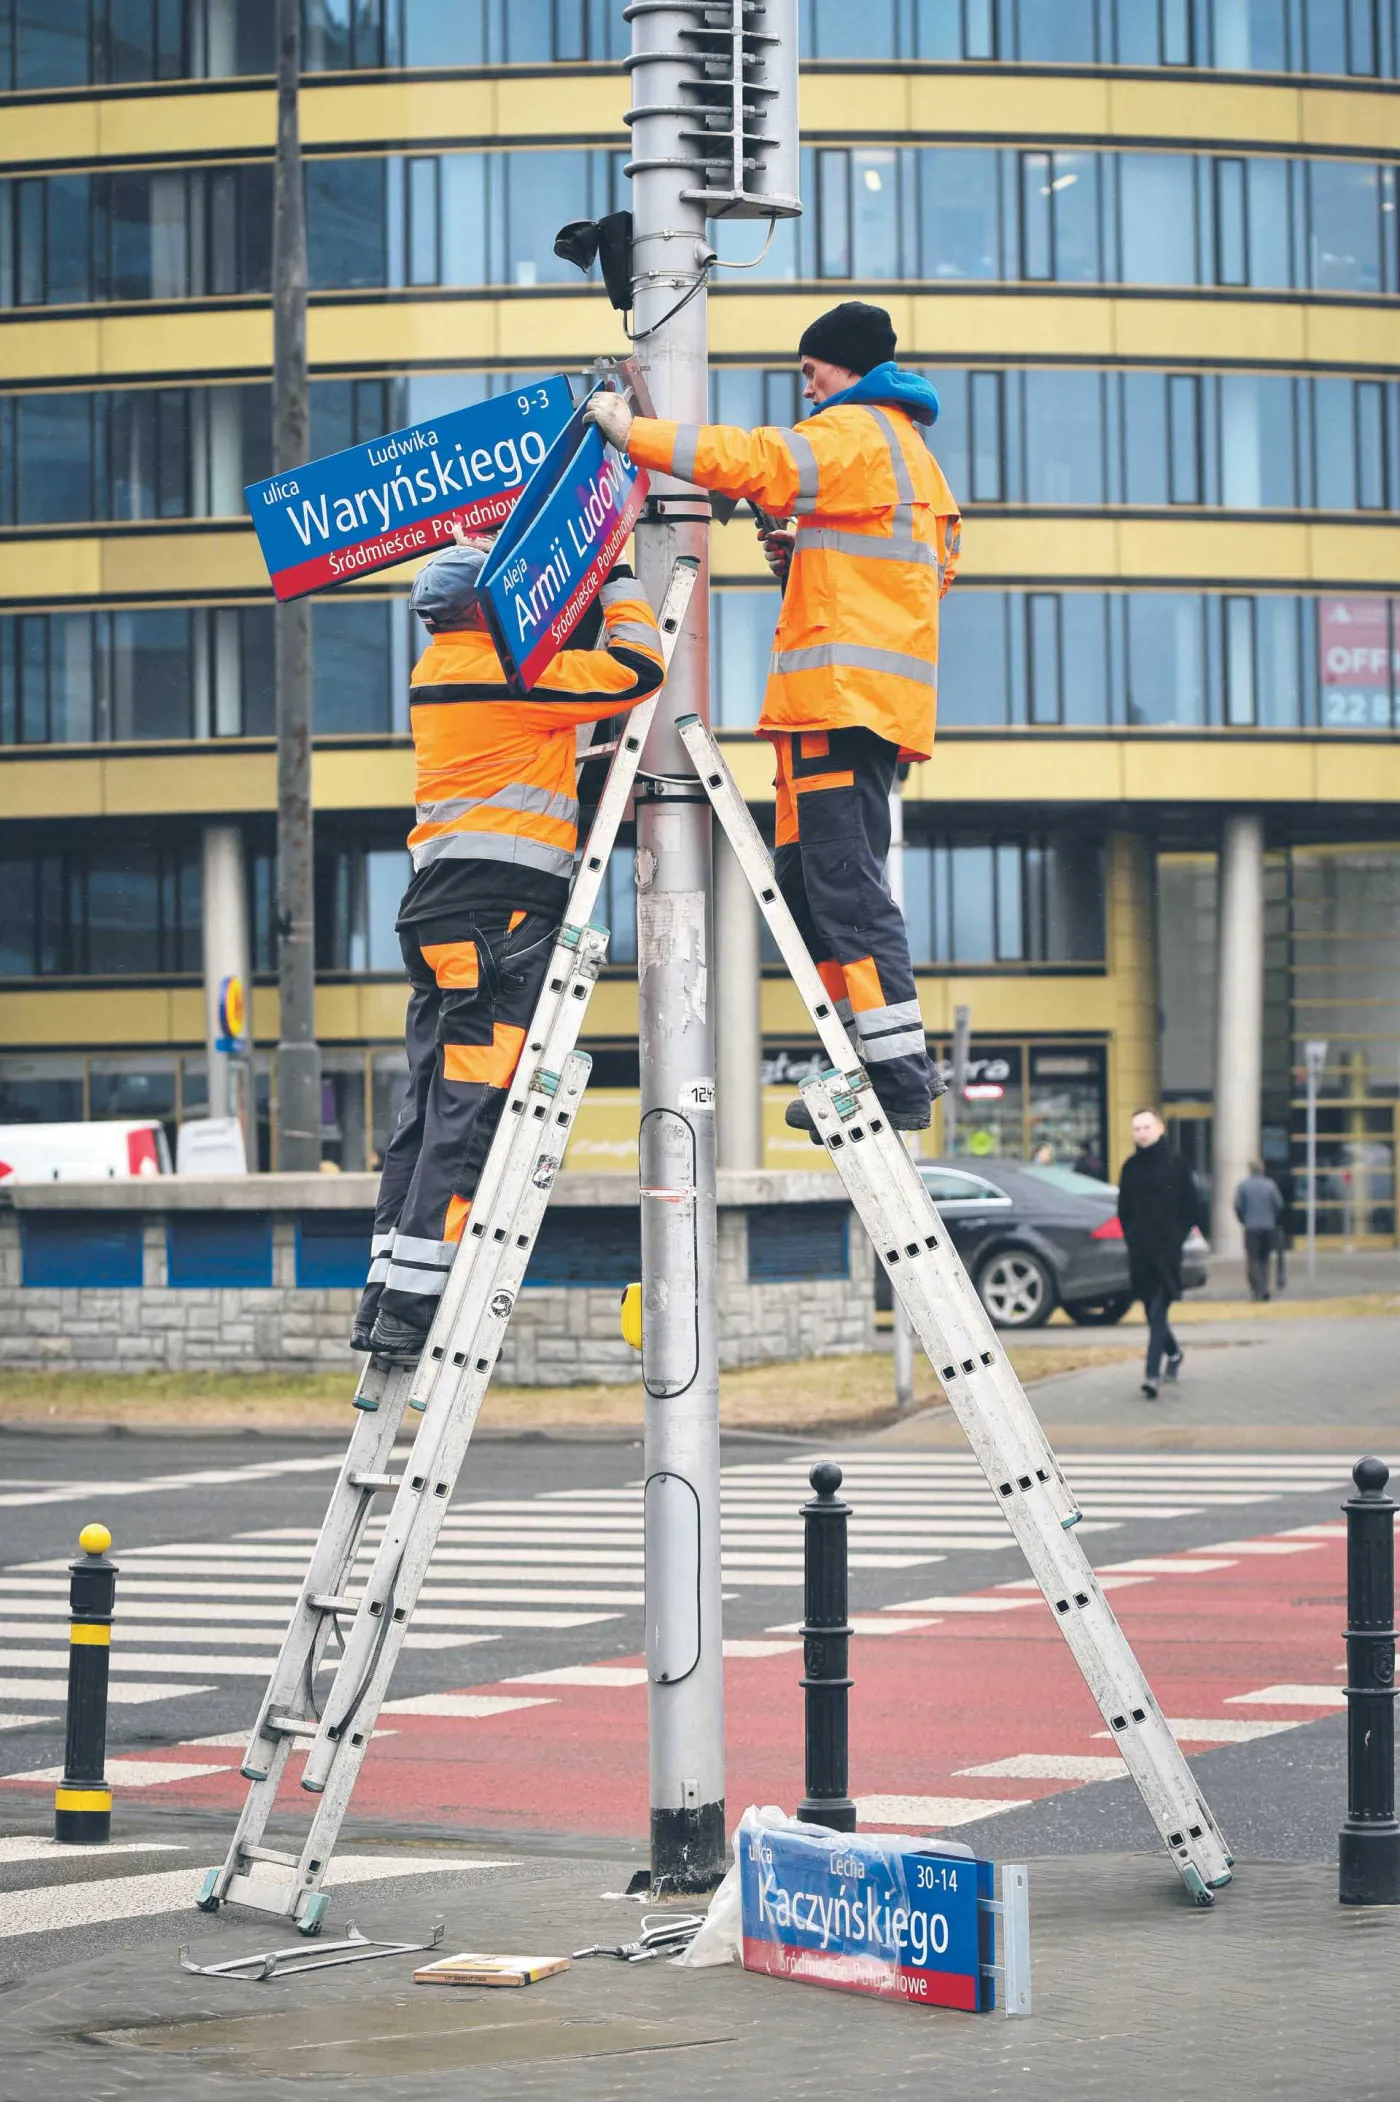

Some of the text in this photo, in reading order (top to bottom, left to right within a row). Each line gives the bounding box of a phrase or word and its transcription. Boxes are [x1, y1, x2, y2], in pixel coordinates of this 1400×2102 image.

[518, 389, 549, 416] 9-3
[367, 430, 439, 467] Ludwika
[262, 479, 300, 505] ulica
[286, 430, 547, 547] Waryńskiego
[328, 495, 522, 575] Śródmieście Poudniow
[514, 449, 638, 643] Armii Ludowe
[502, 557, 527, 596] Aleja
[551, 504, 635, 645] Śródmieście Południowe
[1327, 646, 1400, 674] OFF
[830, 1852, 865, 1879] Lecha
[916, 1864, 958, 1893] 30-14
[758, 1872, 949, 1966] Kaczyńskiego
